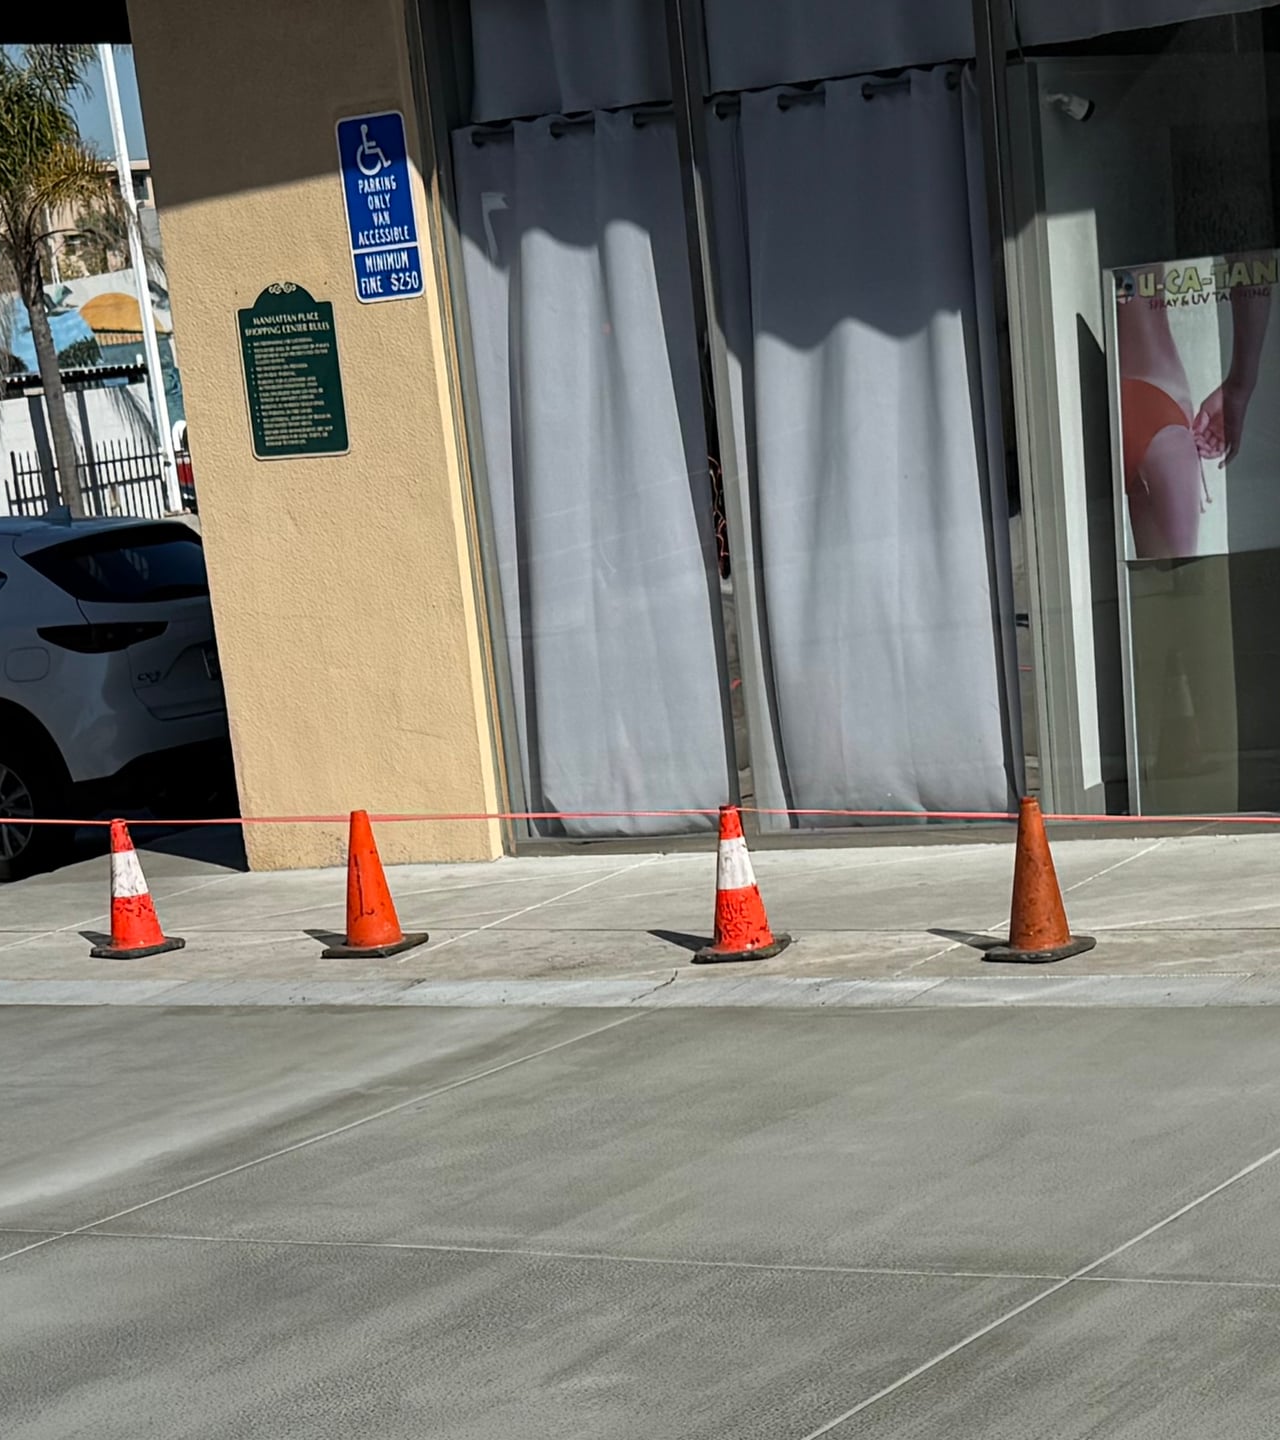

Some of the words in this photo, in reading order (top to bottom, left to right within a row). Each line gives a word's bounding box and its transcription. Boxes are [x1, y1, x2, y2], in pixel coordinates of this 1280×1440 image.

[358, 175, 397, 194] PARKING
[368, 193, 391, 210] ONLY
[372, 211, 391, 226] VAN
[358, 226, 410, 246] ACCESSIBLE
[365, 250, 409, 273] MINIMUM
[361, 276, 384, 295] FINE
[391, 271, 419, 291] $250
[1138, 257, 1279, 298] U-CA-TAN
[1191, 292, 1210, 305] UV
